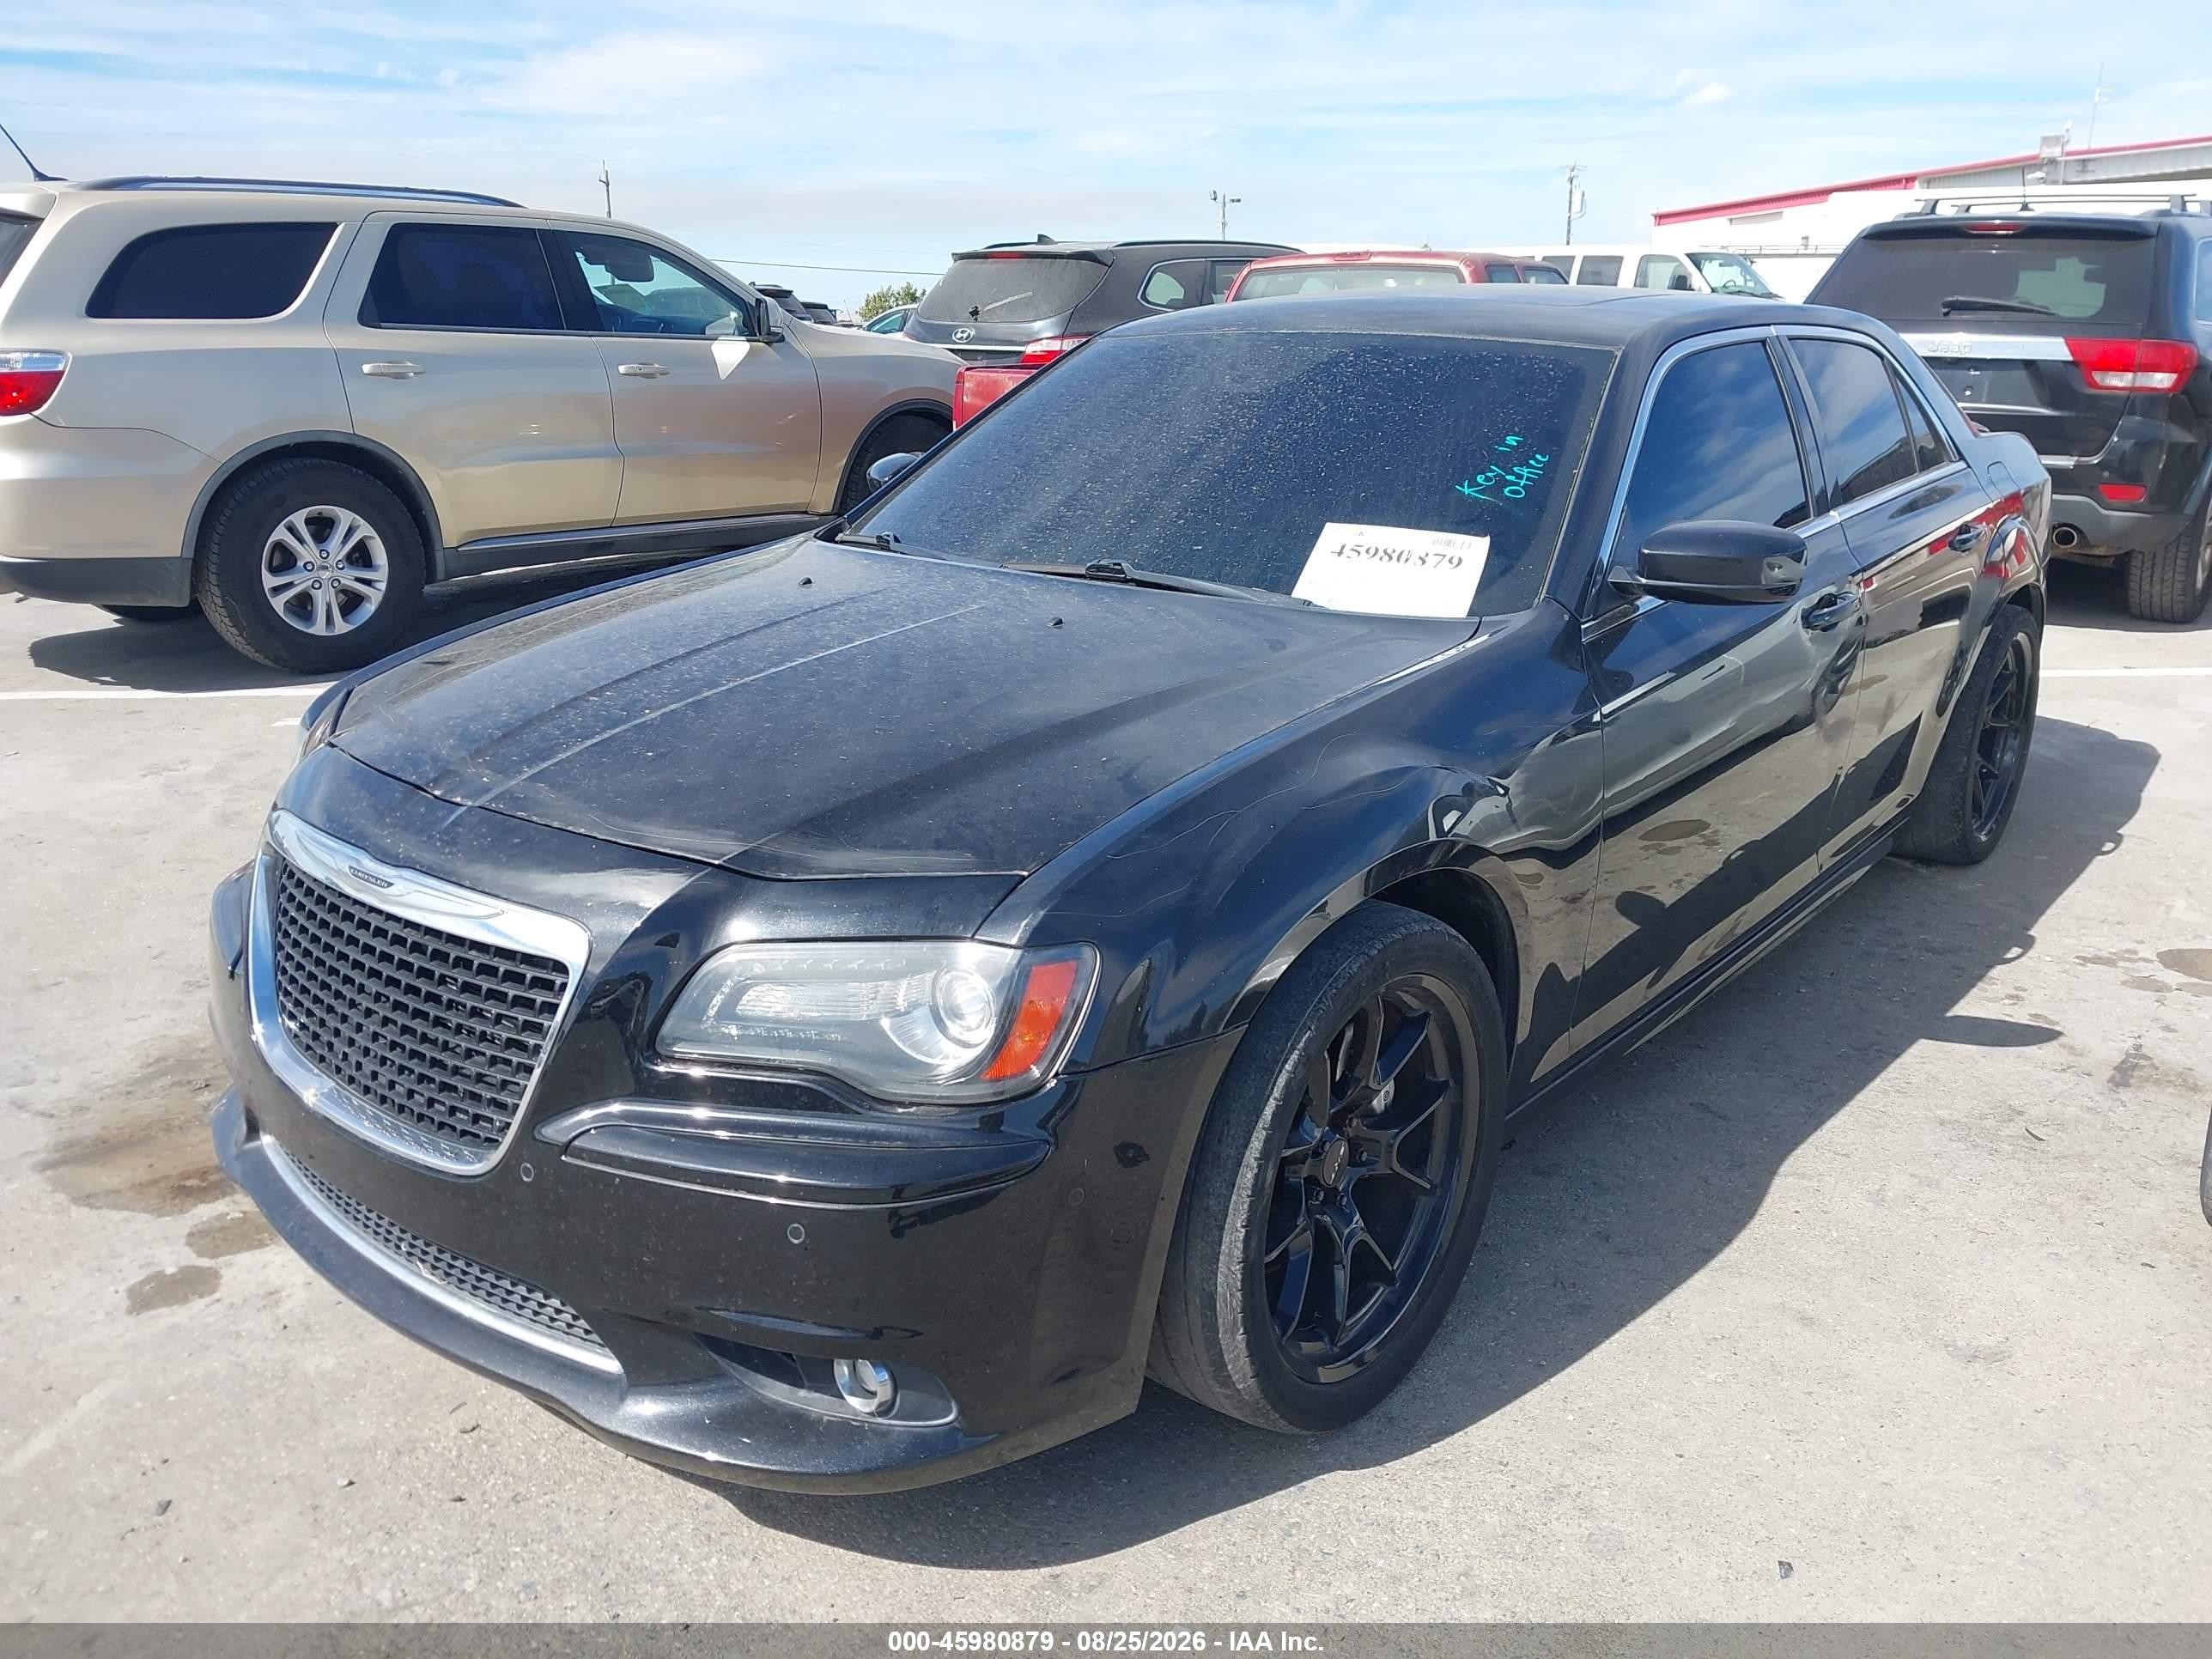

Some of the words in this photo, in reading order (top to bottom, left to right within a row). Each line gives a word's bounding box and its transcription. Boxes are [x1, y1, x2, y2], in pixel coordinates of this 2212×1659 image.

[1455, 465, 1506, 505] Key
[1494, 434, 1524, 452] in
[349, 867, 389, 888] CHRYSLER
